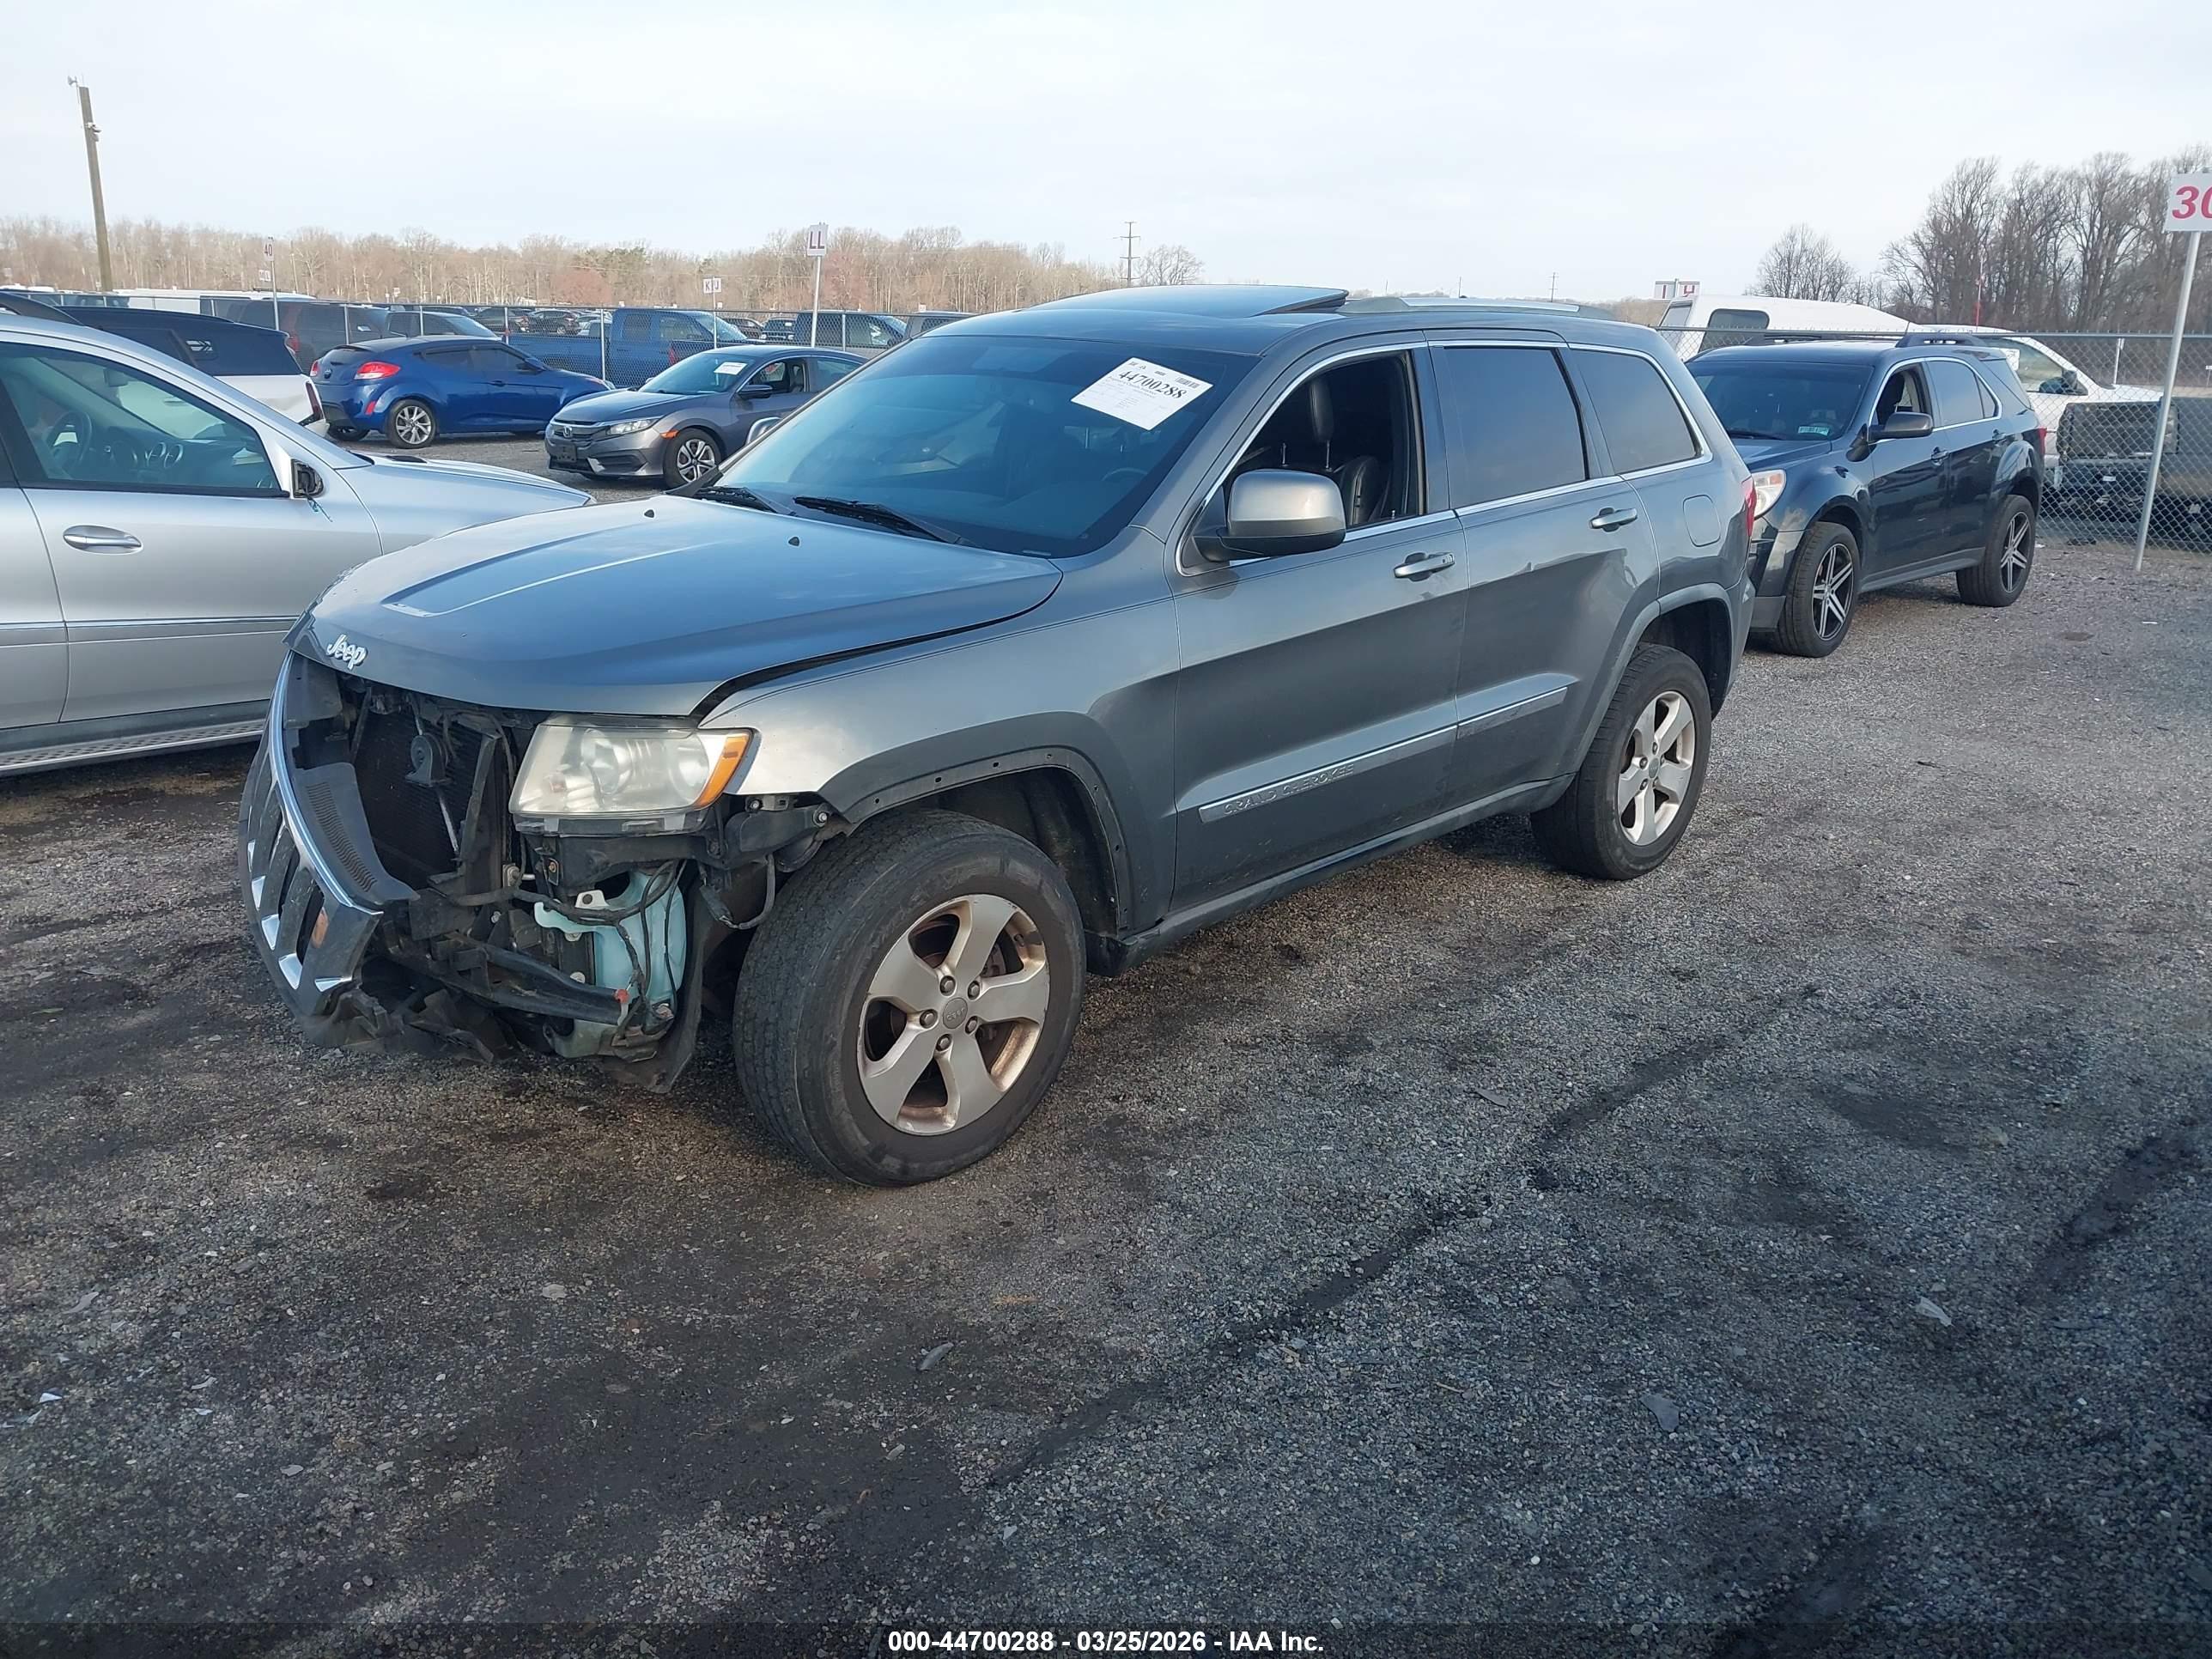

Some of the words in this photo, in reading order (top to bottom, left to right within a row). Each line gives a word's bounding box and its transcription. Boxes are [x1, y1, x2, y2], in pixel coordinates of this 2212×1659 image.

[809, 231, 825, 249] LL
[264, 244, 272, 256] 40
[705, 281, 711, 291] K
[714, 281, 719, 290] J
[1119, 370, 1188, 399] 44700288
[326, 634, 368, 670] Jeep
[1224, 789, 1278, 815] GRAND
[1282, 763, 1354, 796] CHEROKEE
